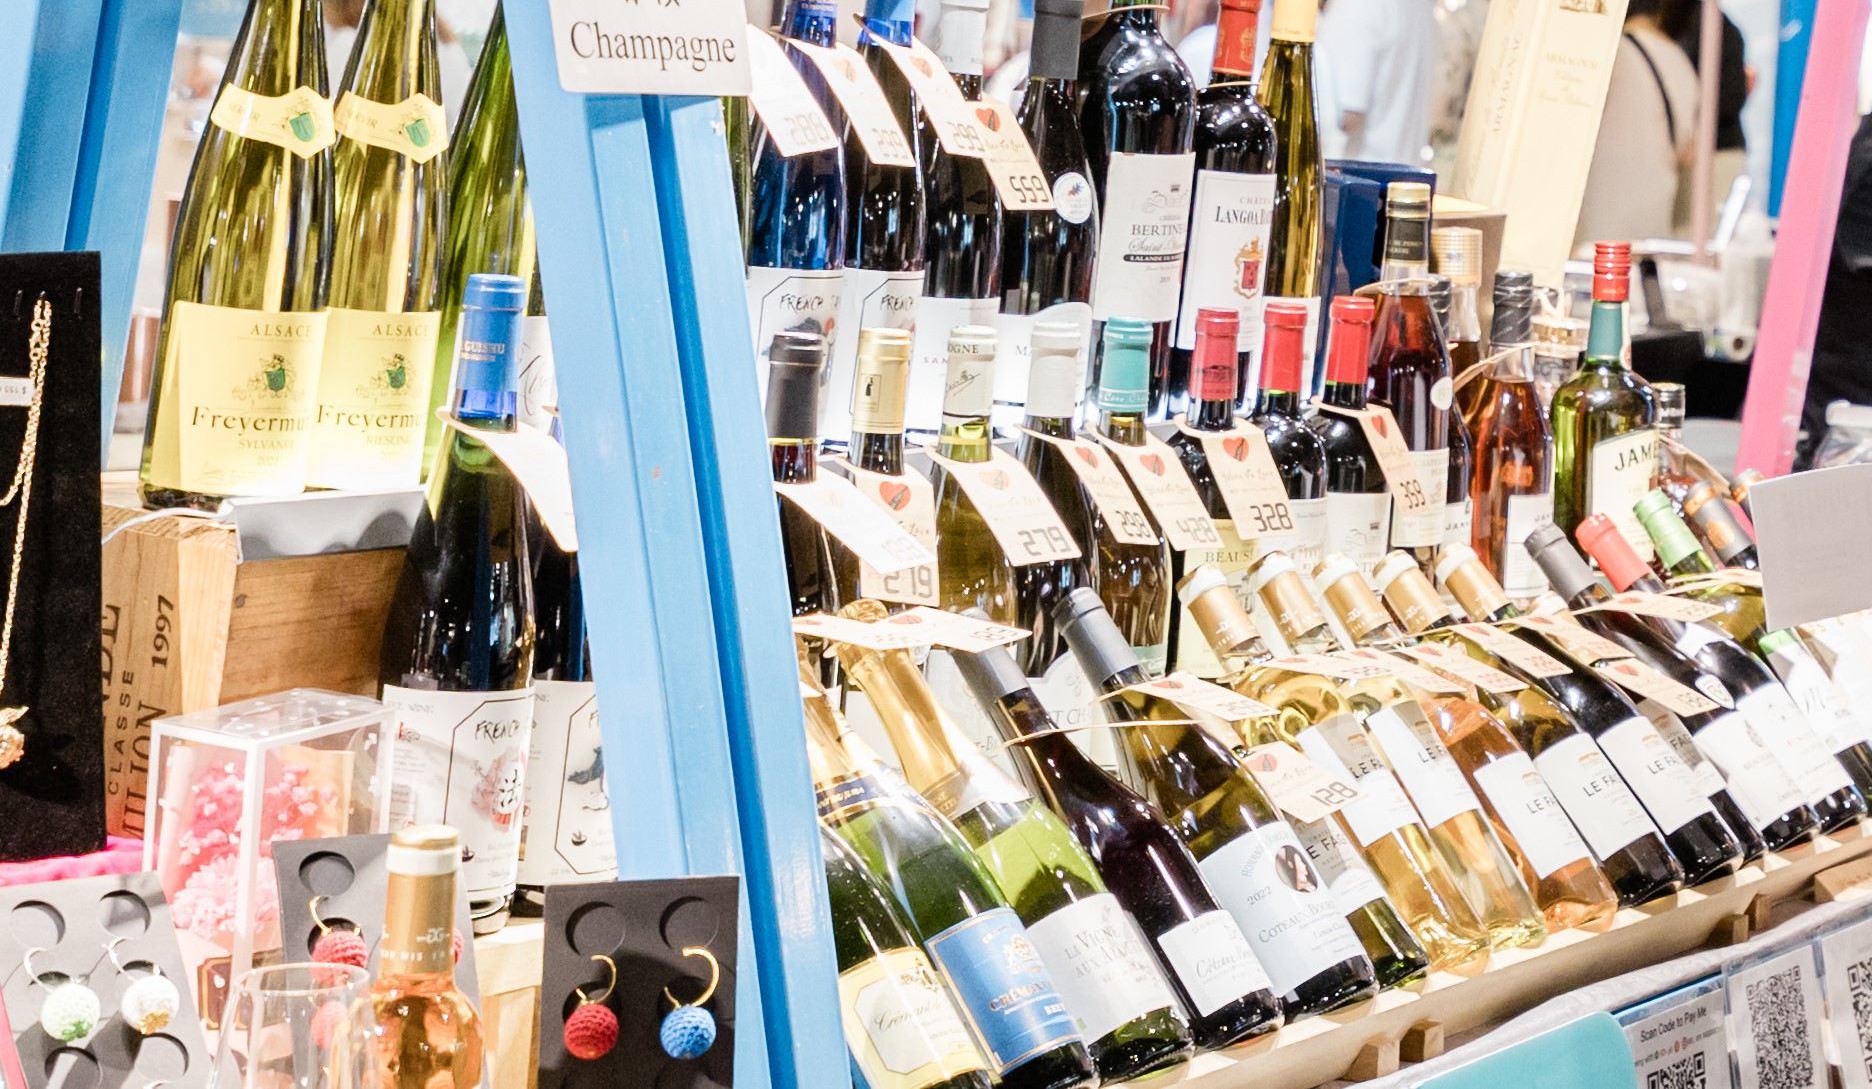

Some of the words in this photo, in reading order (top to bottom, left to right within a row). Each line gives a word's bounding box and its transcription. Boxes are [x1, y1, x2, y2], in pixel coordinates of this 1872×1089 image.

[570, 21, 736, 73] Champagne
[1008, 174, 1050, 204] 559
[1130, 223, 1186, 237] BERTINE
[250, 323, 311, 338] ALSACE
[372, 323, 429, 338] ALSACE
[191, 405, 311, 437] Freyermu
[317, 403, 428, 433] Freyermu
[1614, 440, 1660, 472] JAME
[1175, 516, 1218, 543] 428
[1250, 502, 1294, 533] 328
[1018, 525, 1073, 558] 279
[151, 593, 175, 670] 1997
[1310, 780, 1358, 807] 128
[1582, 780, 1602, 798] LE
[1526, 799, 1545, 814] LE
[1246, 885, 1273, 907] 2022
[1640, 1028, 1657, 1043] Scan
[1658, 1019, 1676, 1035] Code
[1684, 1012, 1696, 1025] Pay
[1697, 1007, 1707, 1019] Me
